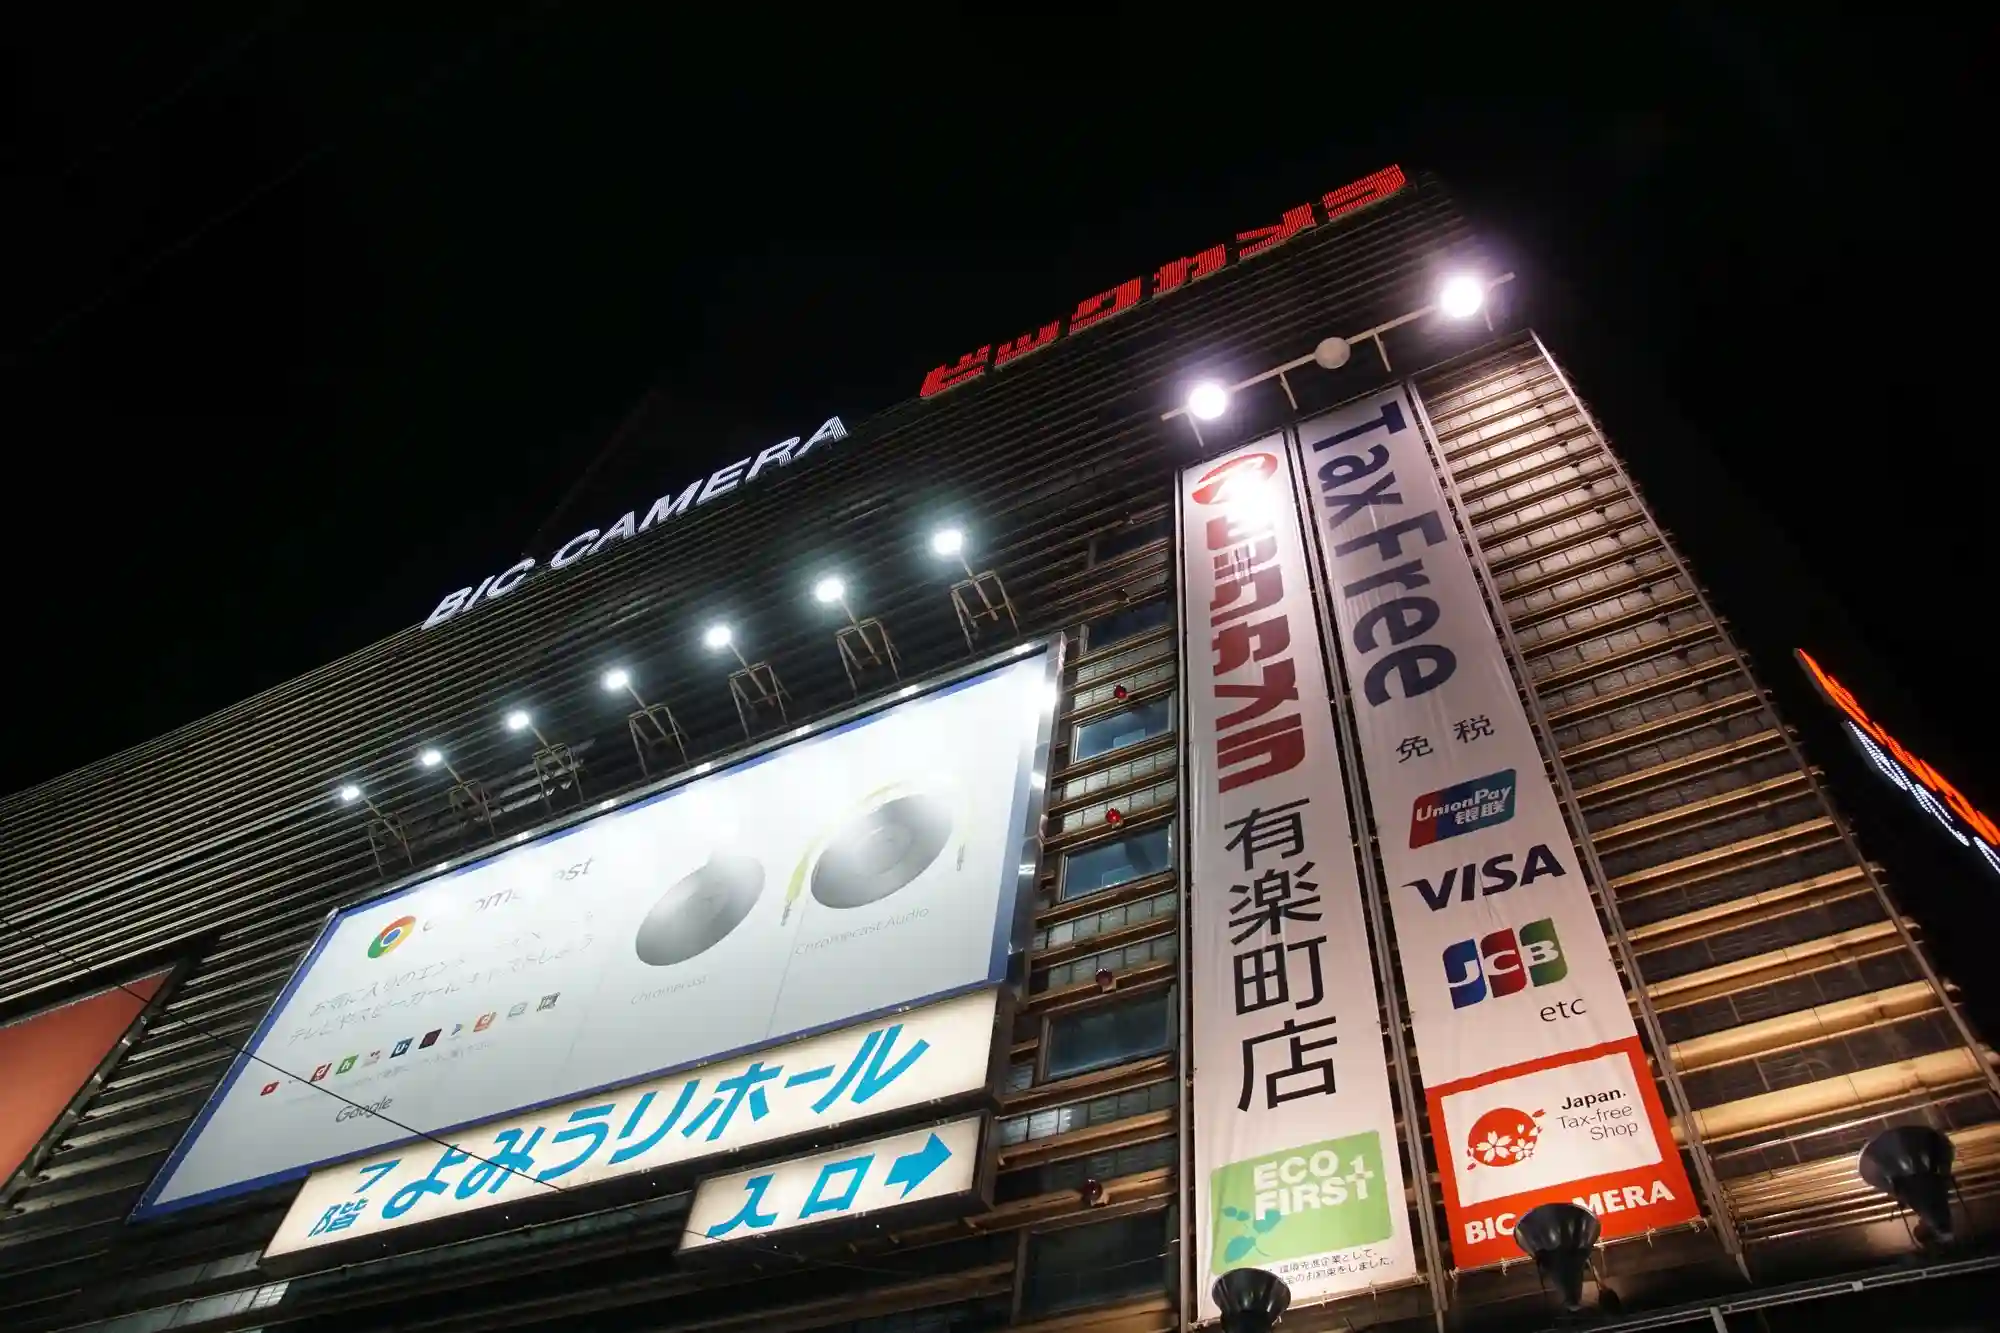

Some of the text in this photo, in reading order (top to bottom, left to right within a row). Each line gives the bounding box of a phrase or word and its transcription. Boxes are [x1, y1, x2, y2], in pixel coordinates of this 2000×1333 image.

[919, 164, 1407, 399] ビックカメラ
[420, 415, 848, 631] BIC CAMERA
[1312, 399, 1457, 708] Tax Free
[1415, 785, 1513, 823] UnionPay
[1400, 843, 1567, 912] VISA
[1224, 797, 1338, 1113] 有楽町店
[1540, 997, 1587, 1023] etc
[335, 1095, 394, 1124] Google
[381, 1022, 931, 1220] よみうりホール
[1556, 1104, 1634, 1130] Tax-free
[1560, 1087, 1627, 1111] Japan.
[1589, 1120, 1639, 1142] Shop
[706, 1153, 877, 1239] 入口
[1253, 1149, 1339, 1192] ECO
[1464, 1180, 1676, 1245] BIC MERA
